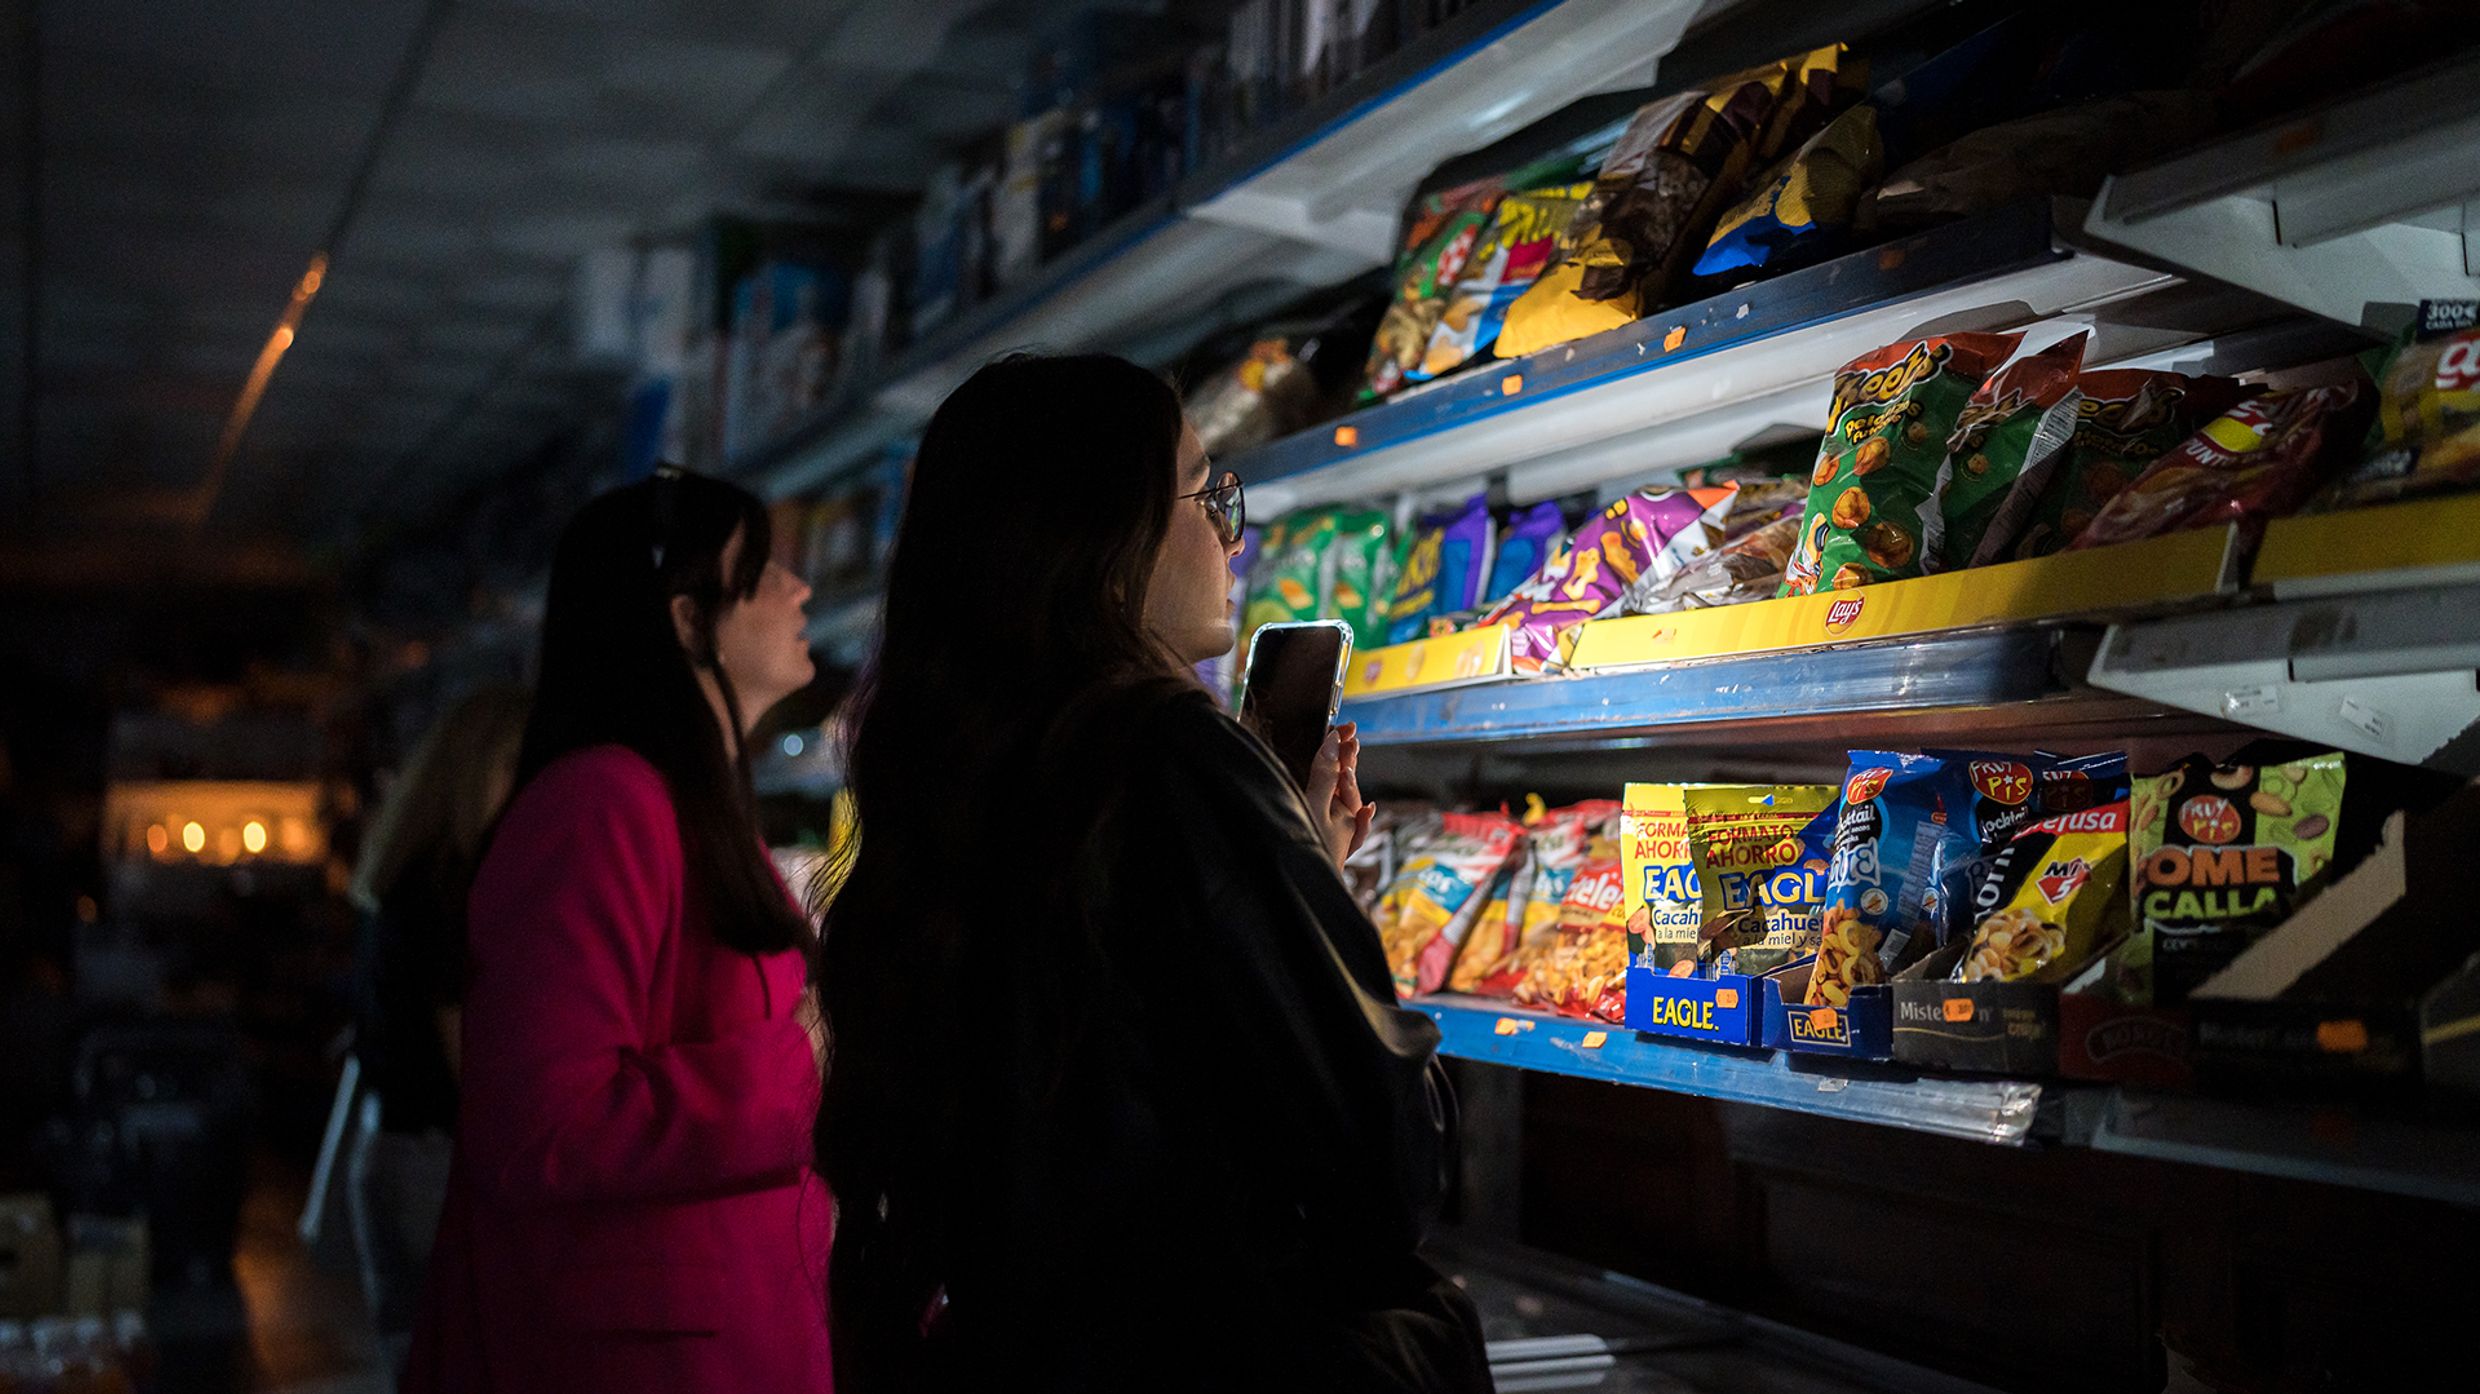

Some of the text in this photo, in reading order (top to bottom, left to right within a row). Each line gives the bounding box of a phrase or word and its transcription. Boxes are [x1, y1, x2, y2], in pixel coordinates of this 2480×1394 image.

[1708, 825, 1794, 845] FORMATO
[1706, 843, 1797, 868] AHORRO
[2146, 848, 2281, 887] OME
[1769, 934, 1795, 947] miel
